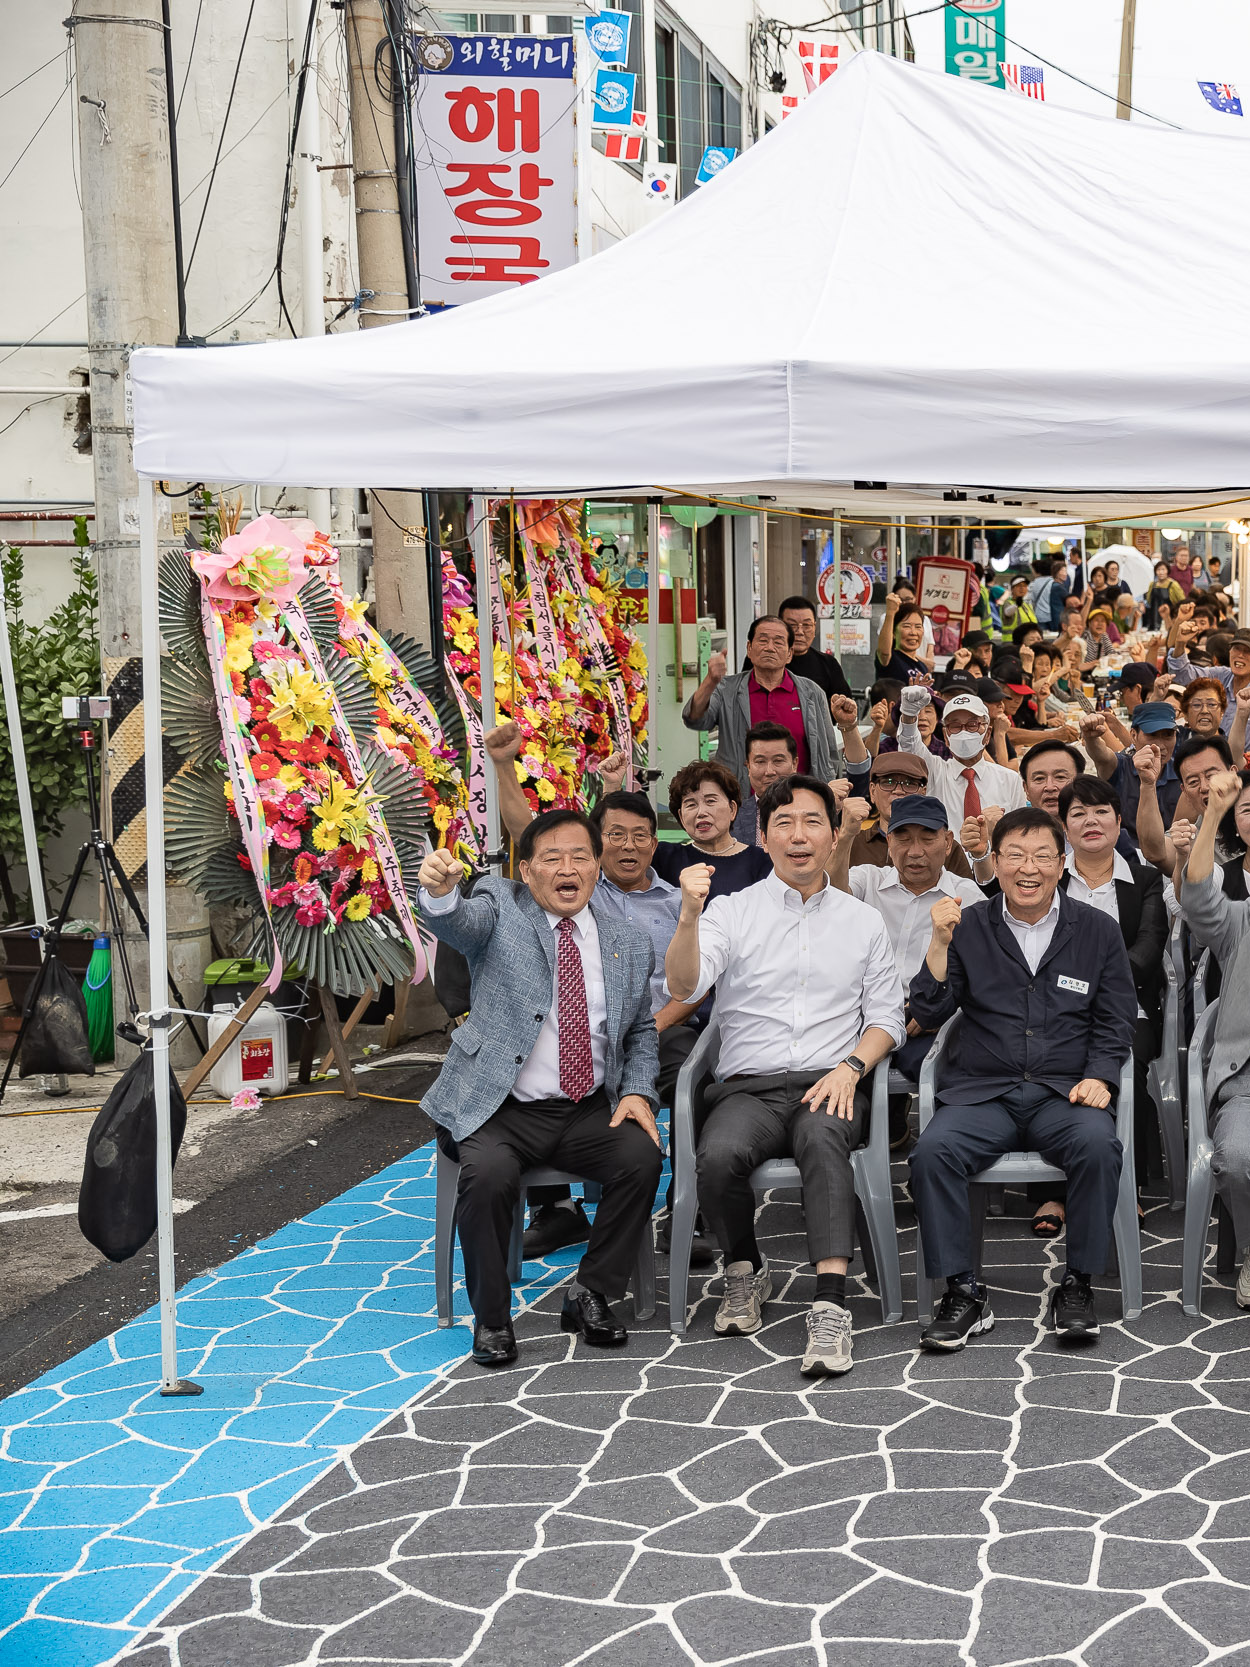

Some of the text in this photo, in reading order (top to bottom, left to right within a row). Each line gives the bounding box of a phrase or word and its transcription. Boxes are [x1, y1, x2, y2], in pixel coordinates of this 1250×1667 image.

[460, 38, 569, 72] 외할머니
[954, 15, 999, 83] 매일
[444, 86, 554, 286] 해장국
